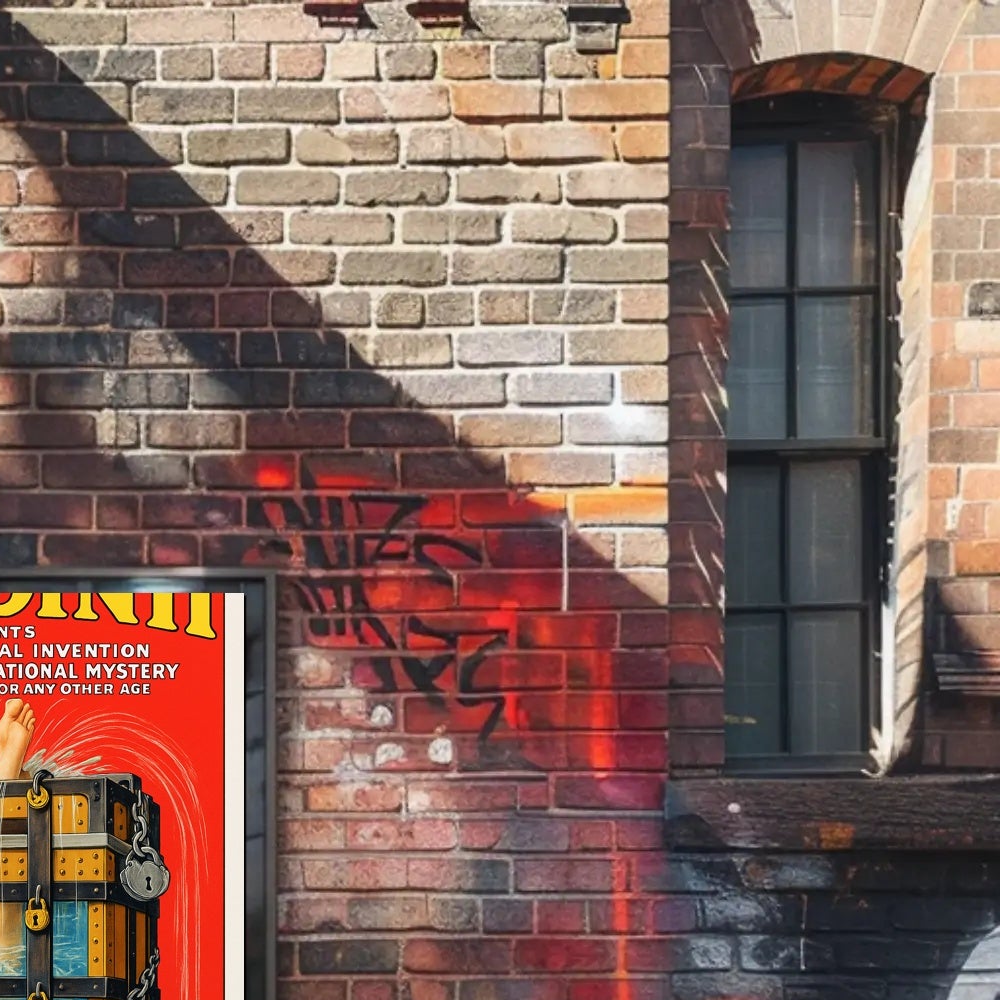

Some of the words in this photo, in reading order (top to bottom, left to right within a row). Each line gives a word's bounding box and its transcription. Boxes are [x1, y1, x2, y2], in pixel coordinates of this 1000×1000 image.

[33, 643, 150, 659] INVENTION
[86, 662, 180, 680] MYSTERY
[23, 682, 56, 696] ANY
[60, 682, 114, 696] OTHER
[119, 682, 151, 696] AGE
